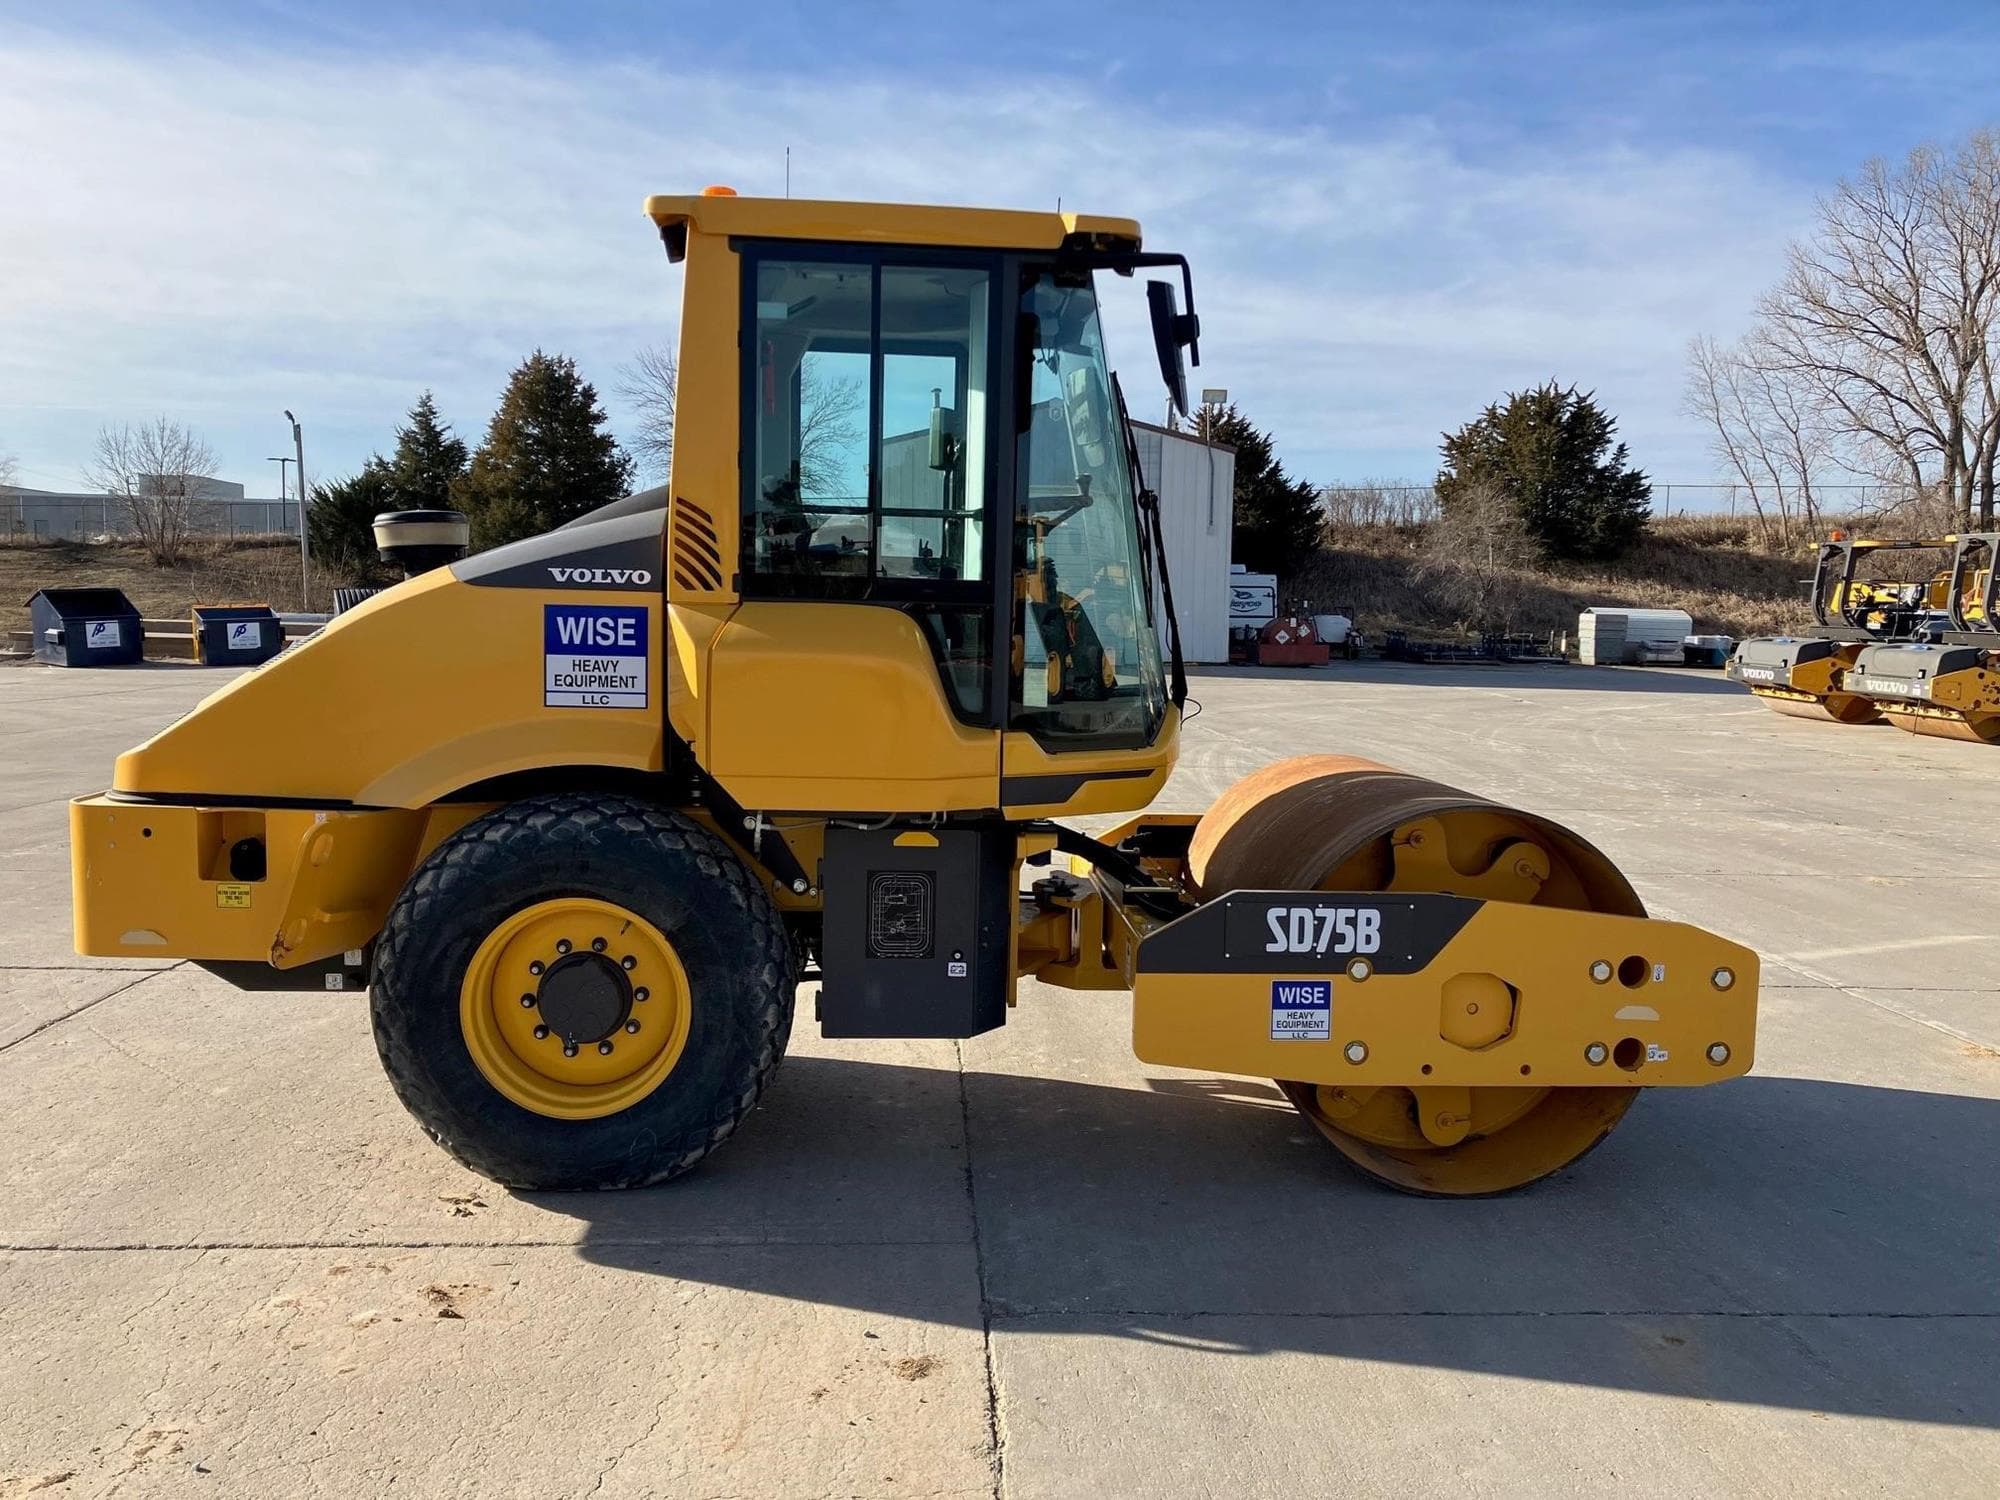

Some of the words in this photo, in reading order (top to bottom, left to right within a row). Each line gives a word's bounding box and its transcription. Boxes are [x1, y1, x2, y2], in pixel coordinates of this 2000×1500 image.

[547, 567, 652, 585] VOLVO
[556, 616, 636, 646] WISE
[572, 659, 619, 673] HEAVY
[554, 674, 638, 689] EQUIPMENT
[1742, 668, 1775, 681] VOLVO
[1866, 680, 1908, 694] VOLVO
[582, 695, 610, 705] LLC
[1265, 907, 1381, 953] SD75B
[1278, 987, 1325, 1004] WISE
[1287, 1011, 1315, 1020] HEAVY
[1276, 1021, 1325, 1029] EQUIPMENT
